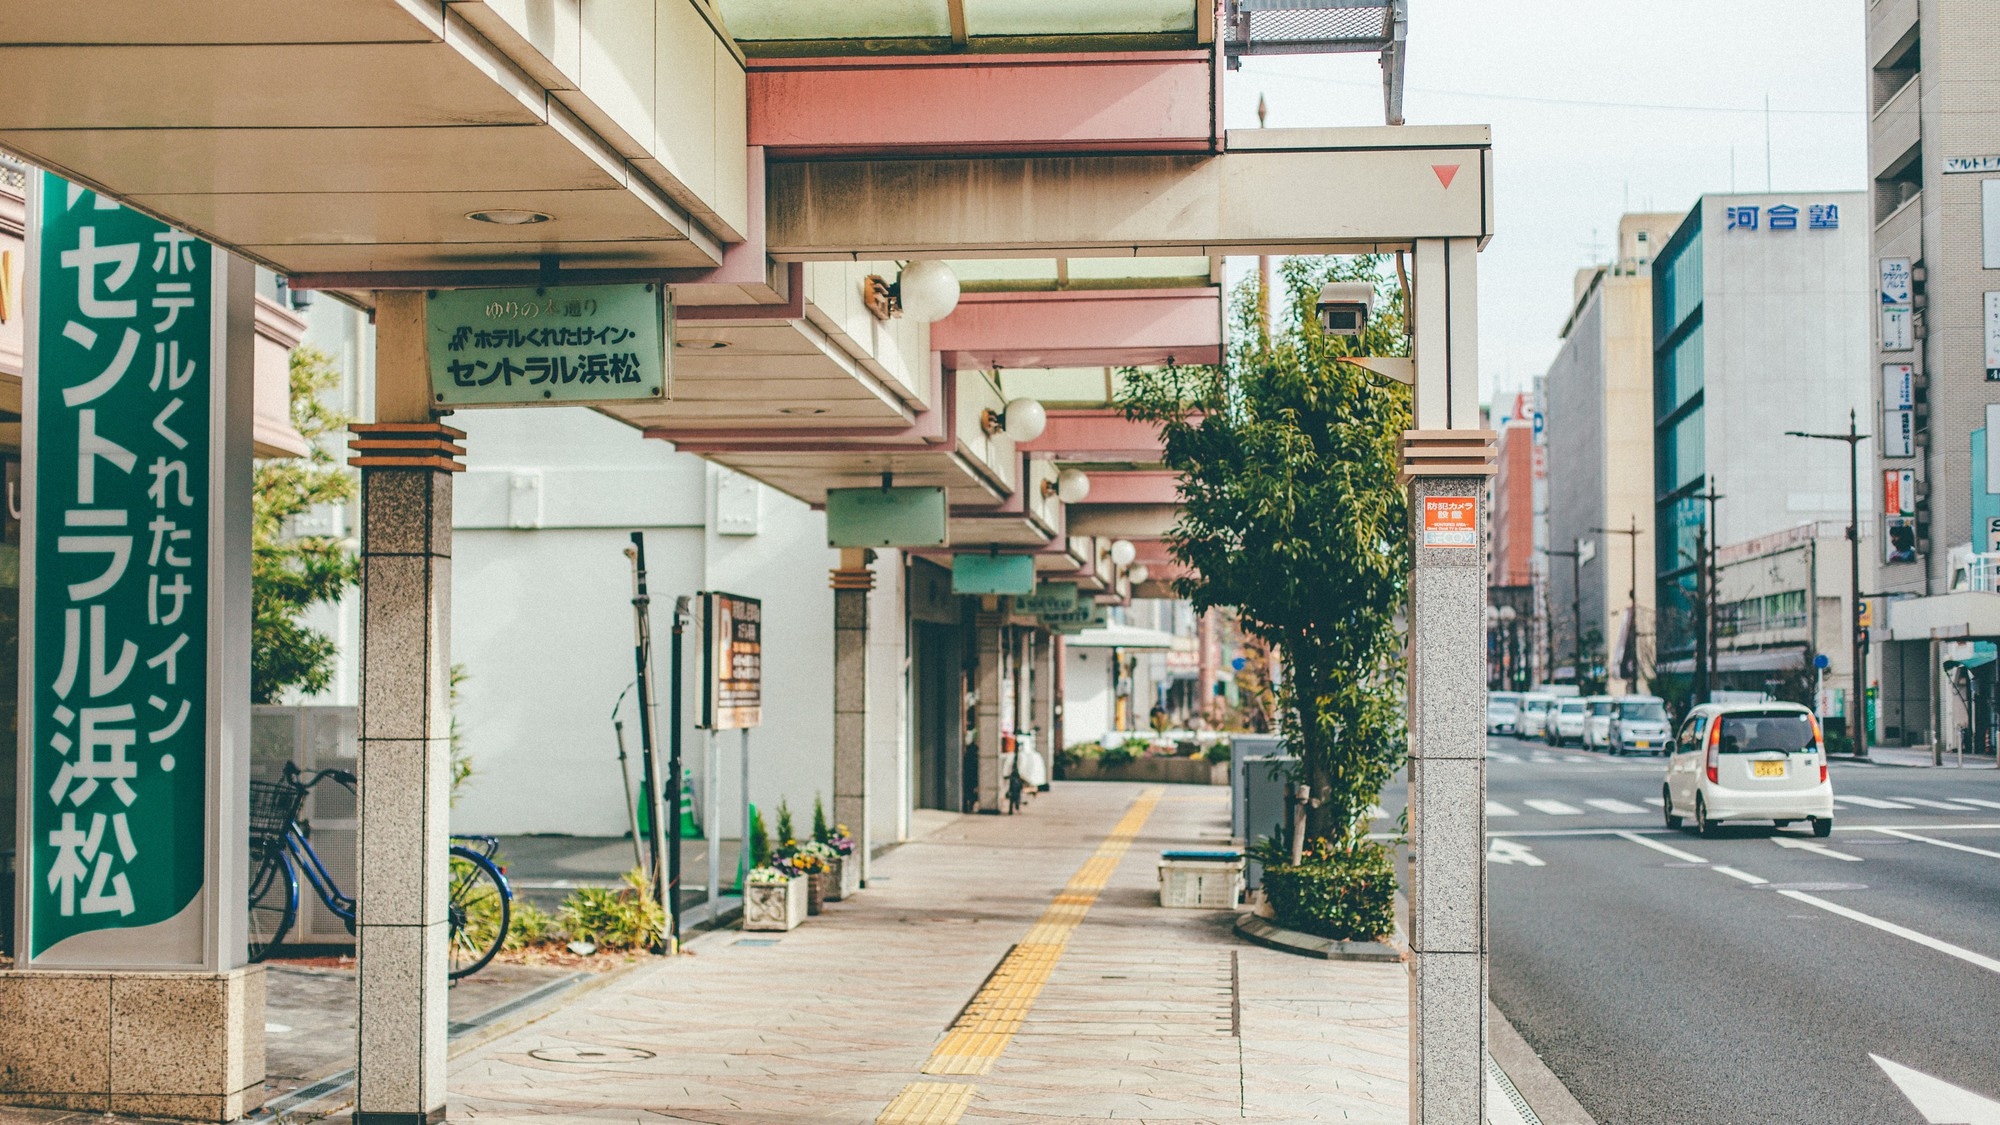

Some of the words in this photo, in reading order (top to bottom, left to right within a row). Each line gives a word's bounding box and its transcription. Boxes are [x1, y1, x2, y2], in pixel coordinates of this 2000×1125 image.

[1727, 203, 1839, 231] 河合塾
[447, 352, 642, 387] セントラル浜松
[147, 226, 197, 773] ホテルくれたけイン・
[1427, 502, 1474, 511] 防犯カメラ
[1426, 531, 1474, 544] SECOM
[48, 226, 141, 917] セントラル浜松
